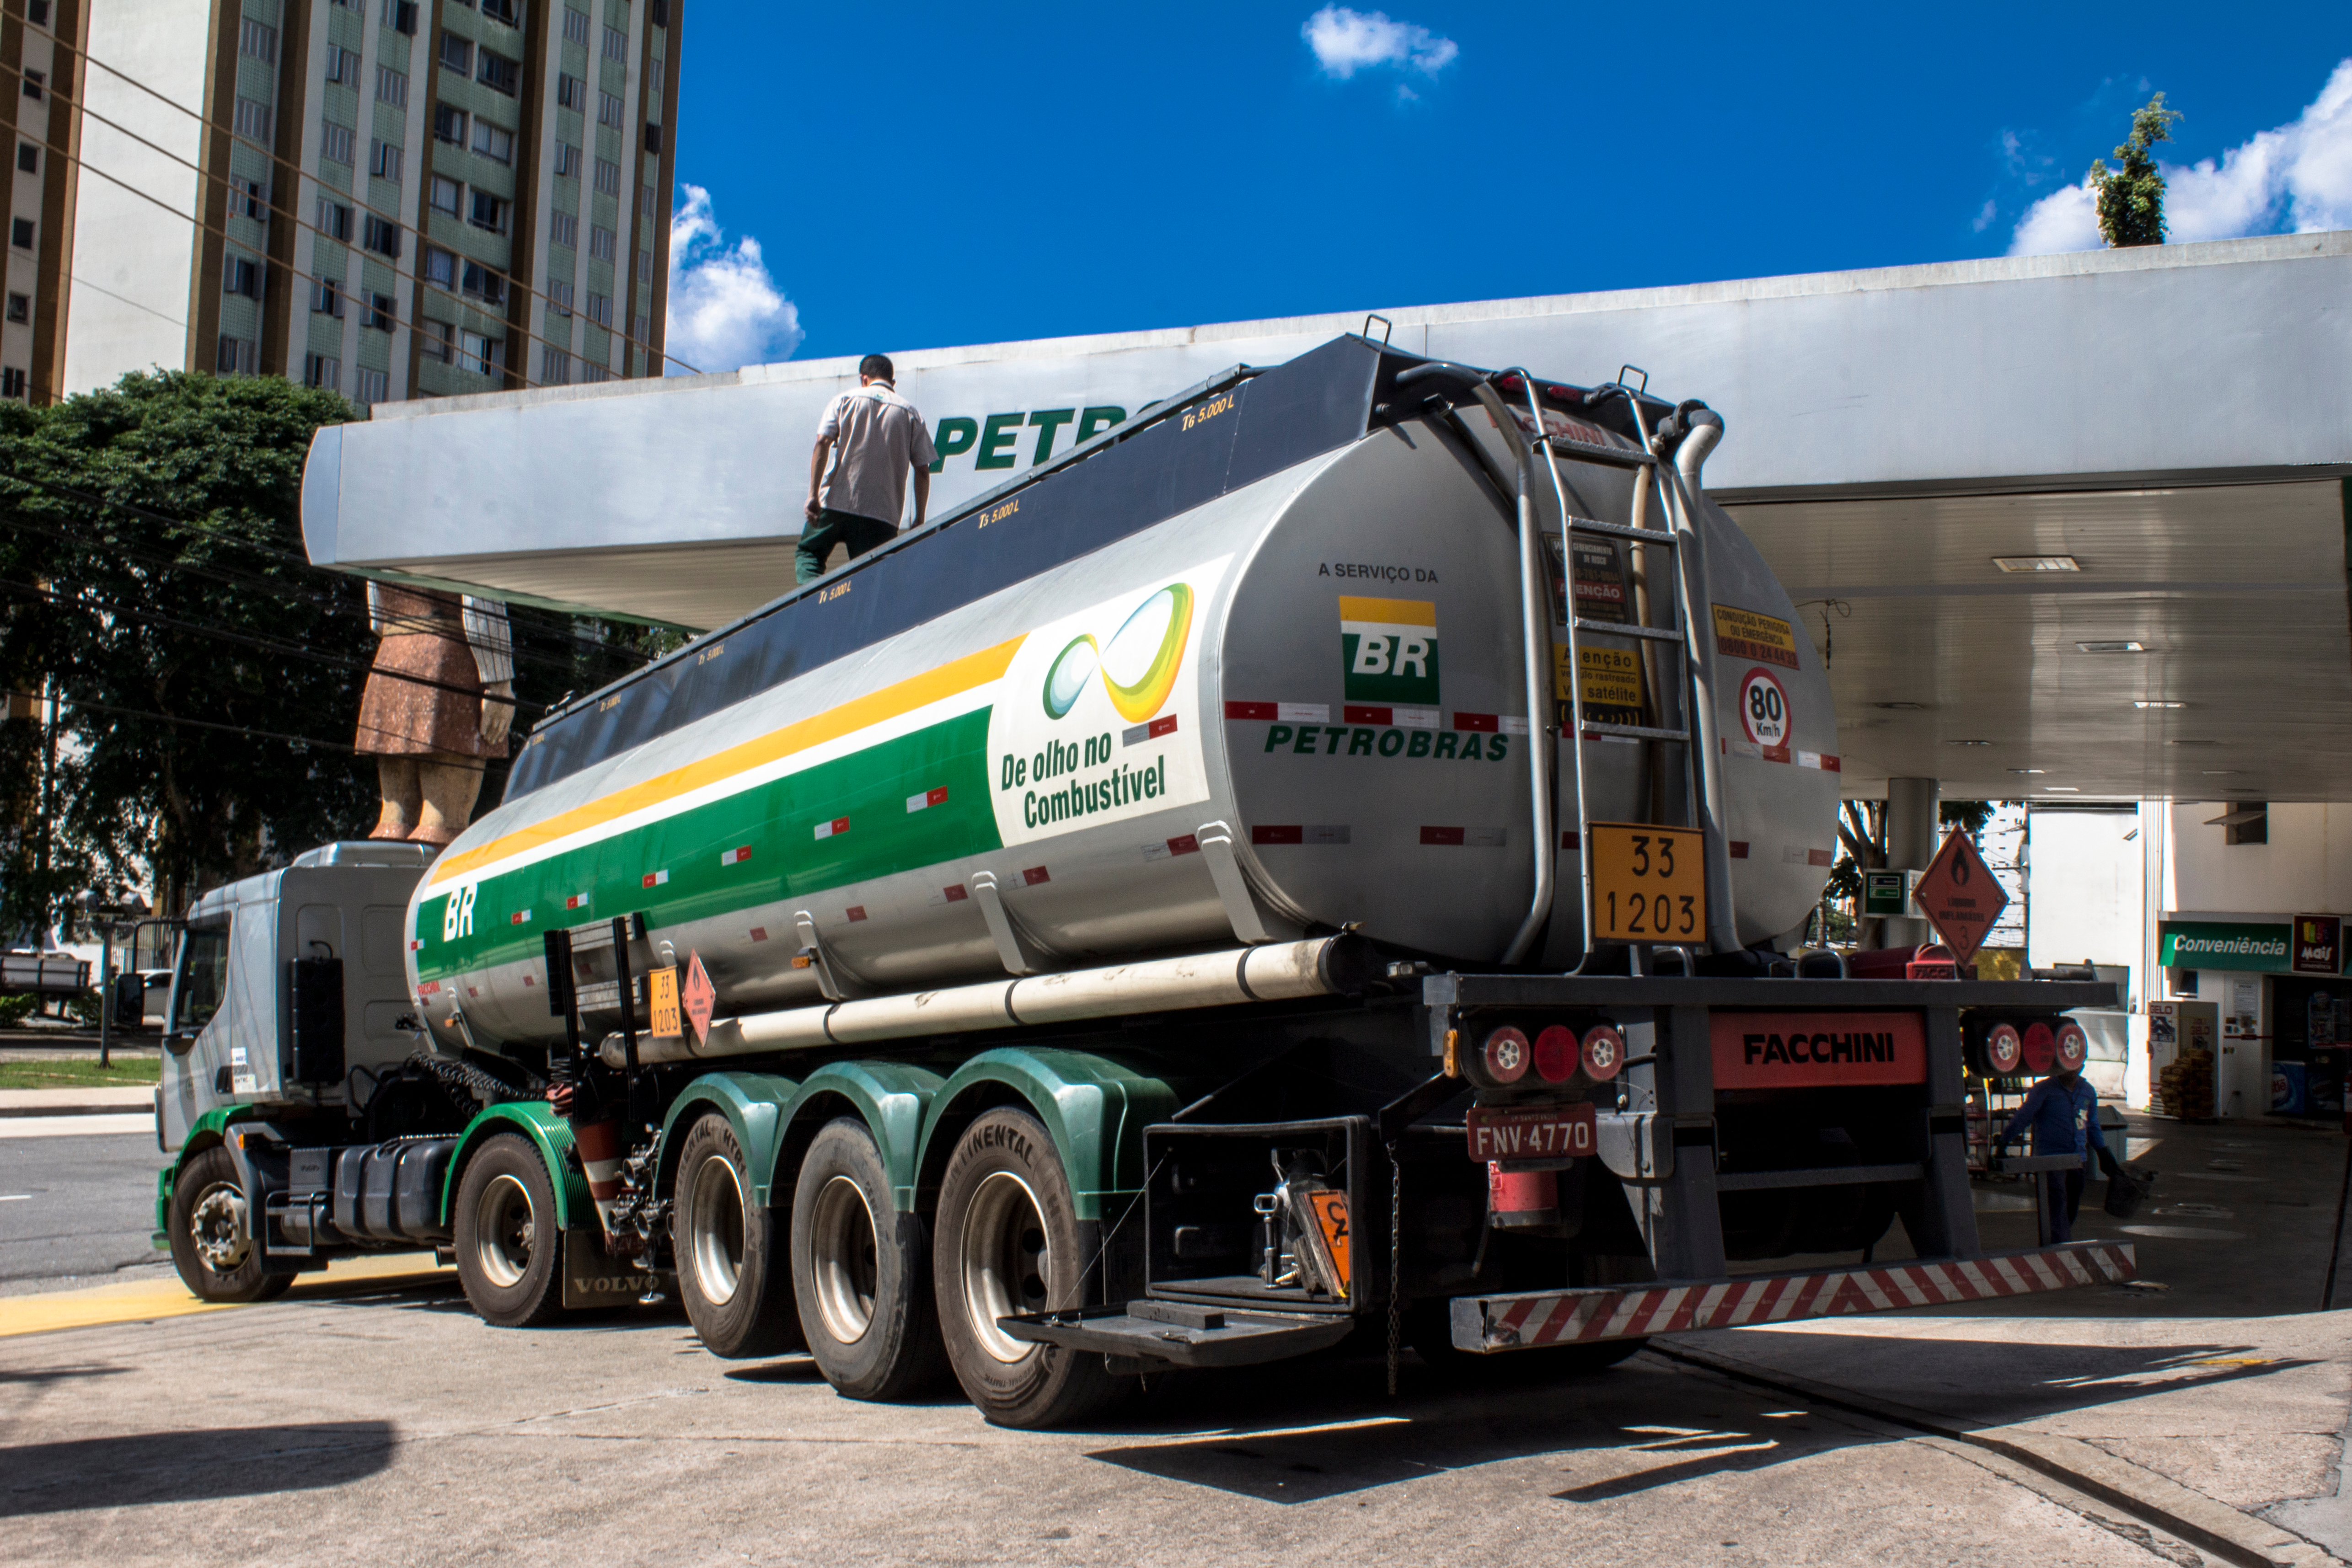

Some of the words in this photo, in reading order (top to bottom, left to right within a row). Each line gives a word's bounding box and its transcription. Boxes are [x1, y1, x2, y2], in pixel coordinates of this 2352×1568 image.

[1182, 413, 1194, 431] T6
[1198, 400, 1226, 423] 5.000
[1227, 394, 1234, 408] L
[979, 514, 989, 529] T5
[991, 503, 1013, 523] 5.000
[1014, 499, 1019, 512] L
[1318, 563, 1330, 576] A
[1335, 563, 1409, 583] SERVIÇO
[1415, 568, 1438, 583] DA
[829, 582, 847, 600] 5.000
[1560, 583, 1620, 599] AENÇÃO
[1717, 609, 1756, 627] CONDUÇÃO
[1759, 618, 1790, 634] PERIGOSA
[1720, 638, 1747, 654] 0800
[1731, 625, 1740, 636] OU
[1742, 627, 1784, 645] EMERGÊNCIA
[1352, 634, 1429, 678] BR
[1564, 648, 1631, 669] Aenção
[1561, 669, 1592, 679] veulo
[1596, 674, 1636, 684] rastreado
[1588, 686, 1635, 701] satélite
[1750, 685, 1781, 721] 80
[1756, 722, 1780, 737] Km/h
[1264, 725, 1509, 761] PETROBRAS
[1002, 754, 1026, 791] De
[1033, 739, 1078, 782] olho
[1084, 732, 1111, 768] no
[1024, 755, 1165, 828] Combustível
[1632, 835, 1674, 878] 33
[444, 883, 478, 942] BR
[1607, 891, 1694, 934] 1203
[1959, 926, 1969, 950] 3
[2175, 934, 2287, 956] Conveniência
[2301, 946, 2332, 961] Mais
[660, 974, 670, 999] 33
[654, 1007, 677, 1033] 1203
[1743, 1033, 1894, 1065] FACCHINI
[574, 1275, 659, 1293] VOLVO
